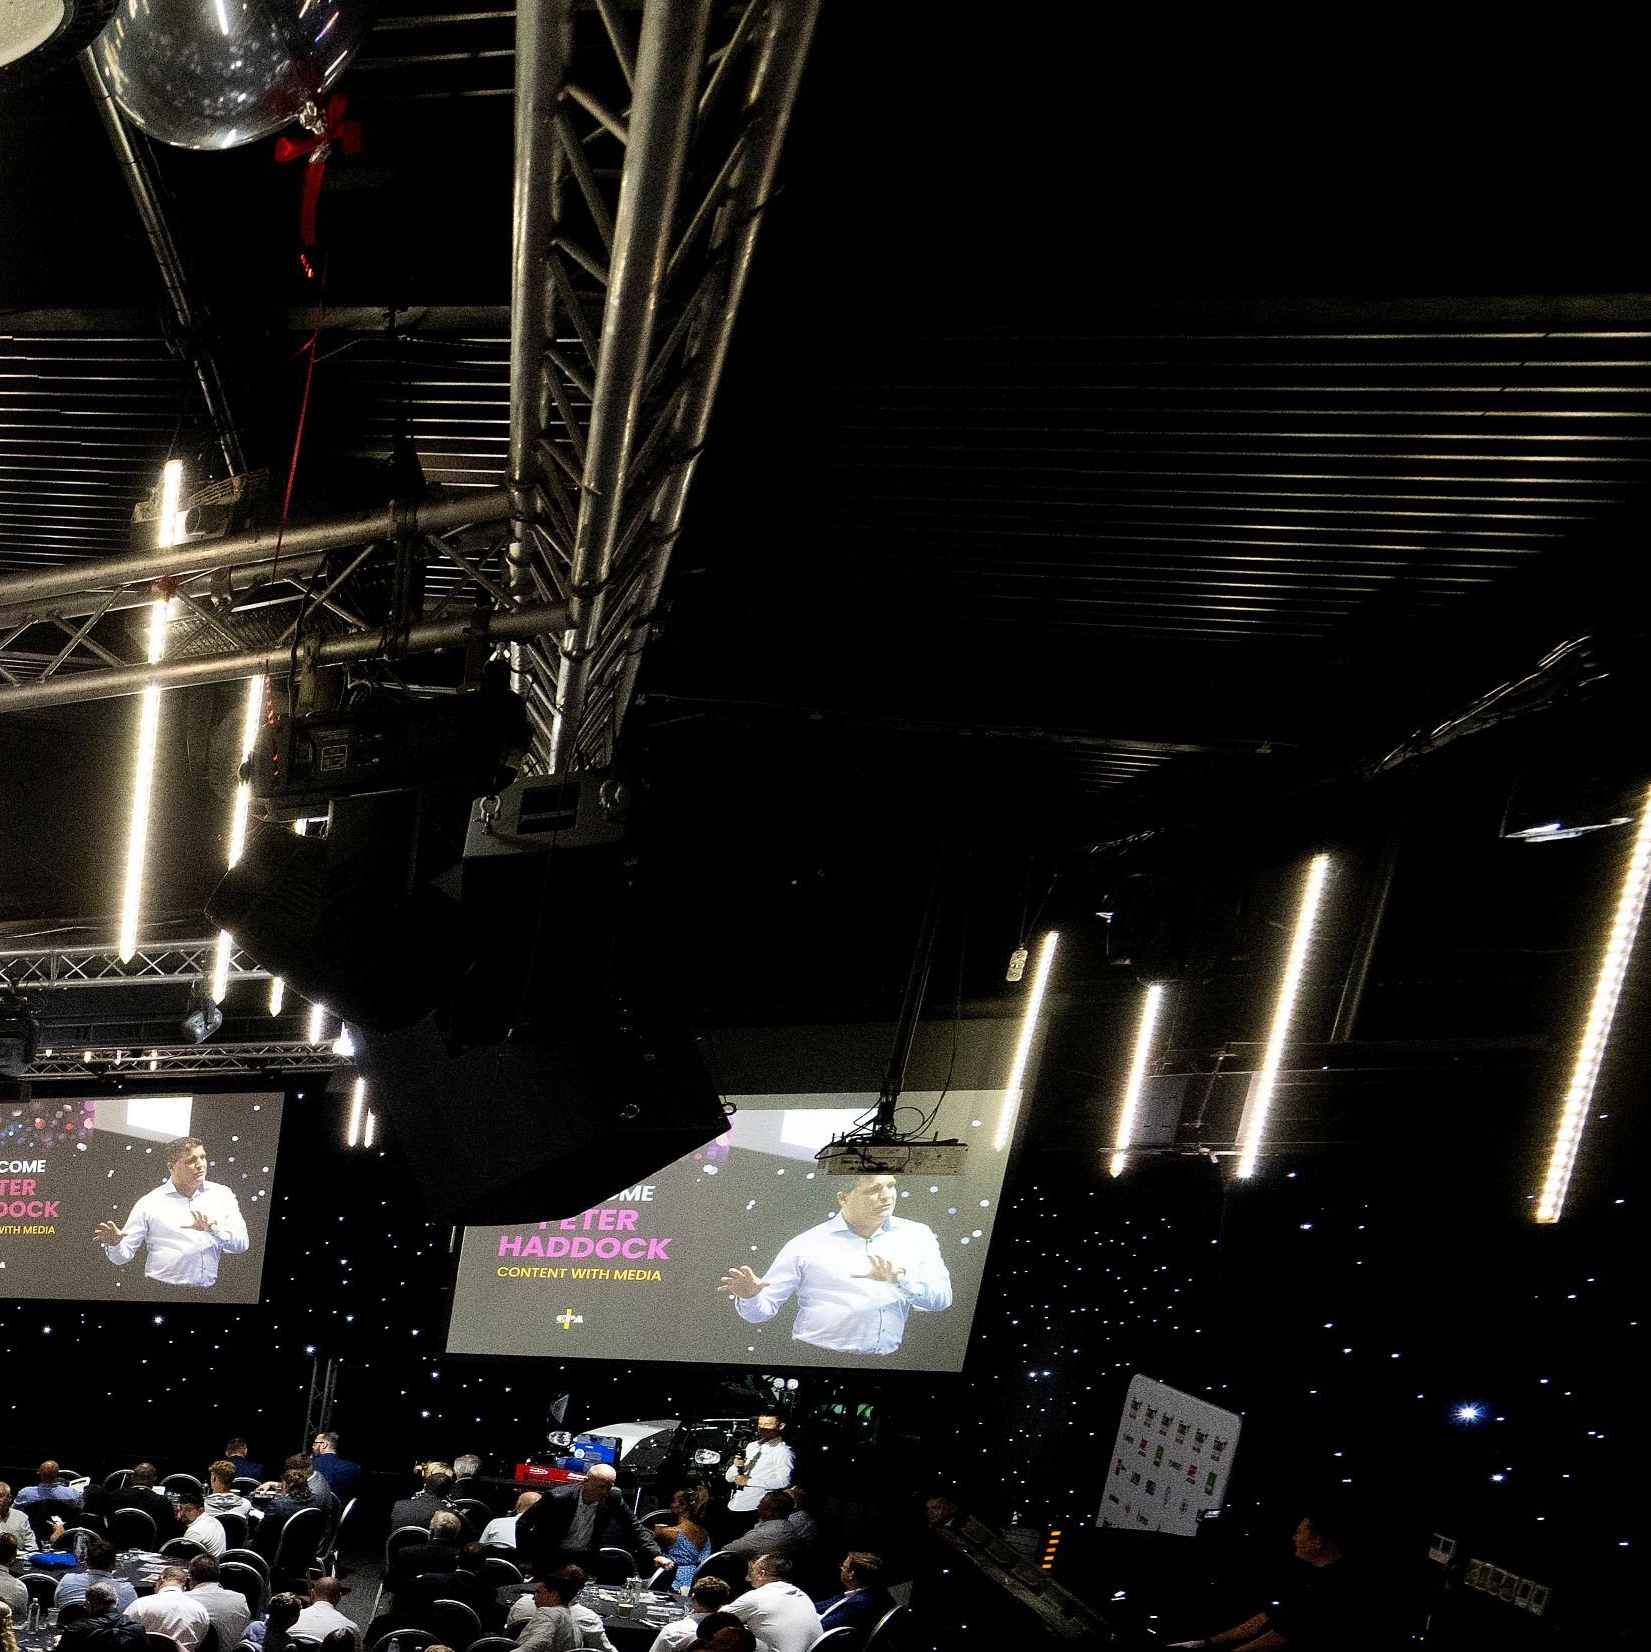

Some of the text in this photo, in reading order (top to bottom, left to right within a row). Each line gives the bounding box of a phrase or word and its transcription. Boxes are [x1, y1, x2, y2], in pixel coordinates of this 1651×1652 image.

[538, 1209, 639, 1231] ETER
[23, 1225, 56, 1235] MEDIA
[498, 1235, 673, 1260] HADDOCK
[497, 1266, 662, 1281] CONTENT WITH MEDIA
